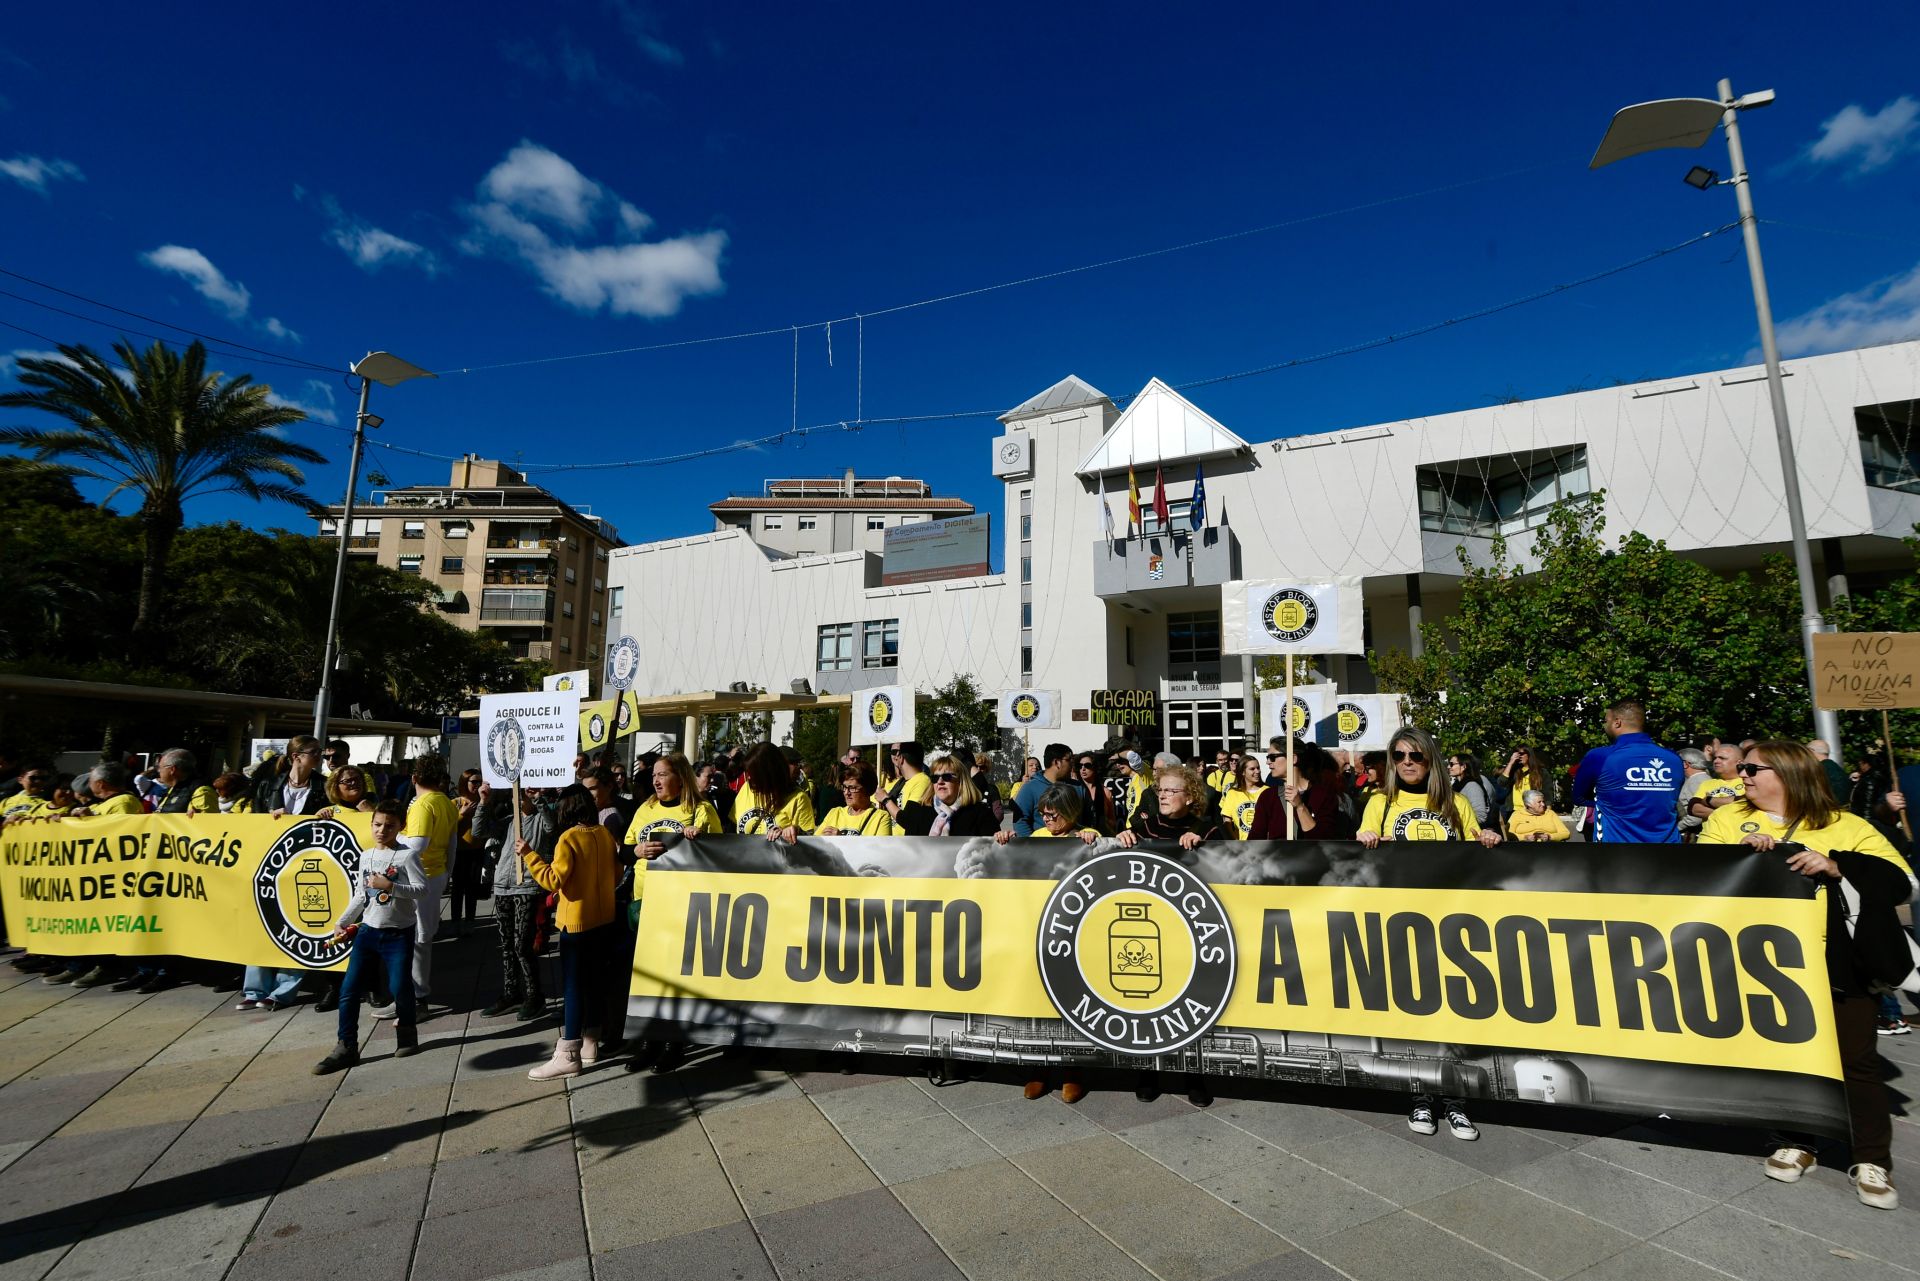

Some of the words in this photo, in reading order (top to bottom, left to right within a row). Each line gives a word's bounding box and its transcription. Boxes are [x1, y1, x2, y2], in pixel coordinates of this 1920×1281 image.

[1265, 595, 1282, 619] STOP
[1287, 591, 1316, 619] BIOGAS
[1852, 637, 1893, 656] NO
[1823, 660, 1838, 671] A
[1853, 659, 1889, 670] UNA
[1093, 690, 1154, 708] CAGADA
[496, 706, 551, 718] AGRIDULCE
[1091, 708, 1156, 726] MONUMENTAL
[446, 718, 457, 731] P
[528, 723, 554, 731] CONTRA
[530, 735, 554, 743] PLANTA
[556, 734, 565, 742] DE
[523, 767, 544, 778] AQUÍ
[547, 767, 566, 777] NO!!
[1626, 767, 1673, 782] CRC
[1396, 814, 1412, 835] STOP
[24, 841, 39, 867] LA
[40, 837, 113, 867] PLANTA
[119, 833, 151, 861] DE
[156, 832, 242, 868] BIOGÁS
[260, 837, 295, 899] STOP
[311, 828, 360, 890] BIOG
[80, 874, 116, 901] DE
[122, 871, 208, 902] SGURA
[1048, 873, 1096, 958] STOP
[1128, 860, 1226, 964] BIOGÁS
[27, 917, 102, 935] PLATAFORMA
[278, 925, 353, 959] MOLIN
[681, 892, 769, 980] NO
[785, 896, 983, 992] JUNTO
[1256, 908, 1308, 1006] A
[1326, 910, 1818, 1044] NOSOTROS
[1071, 993, 1212, 1045] MOLINA
